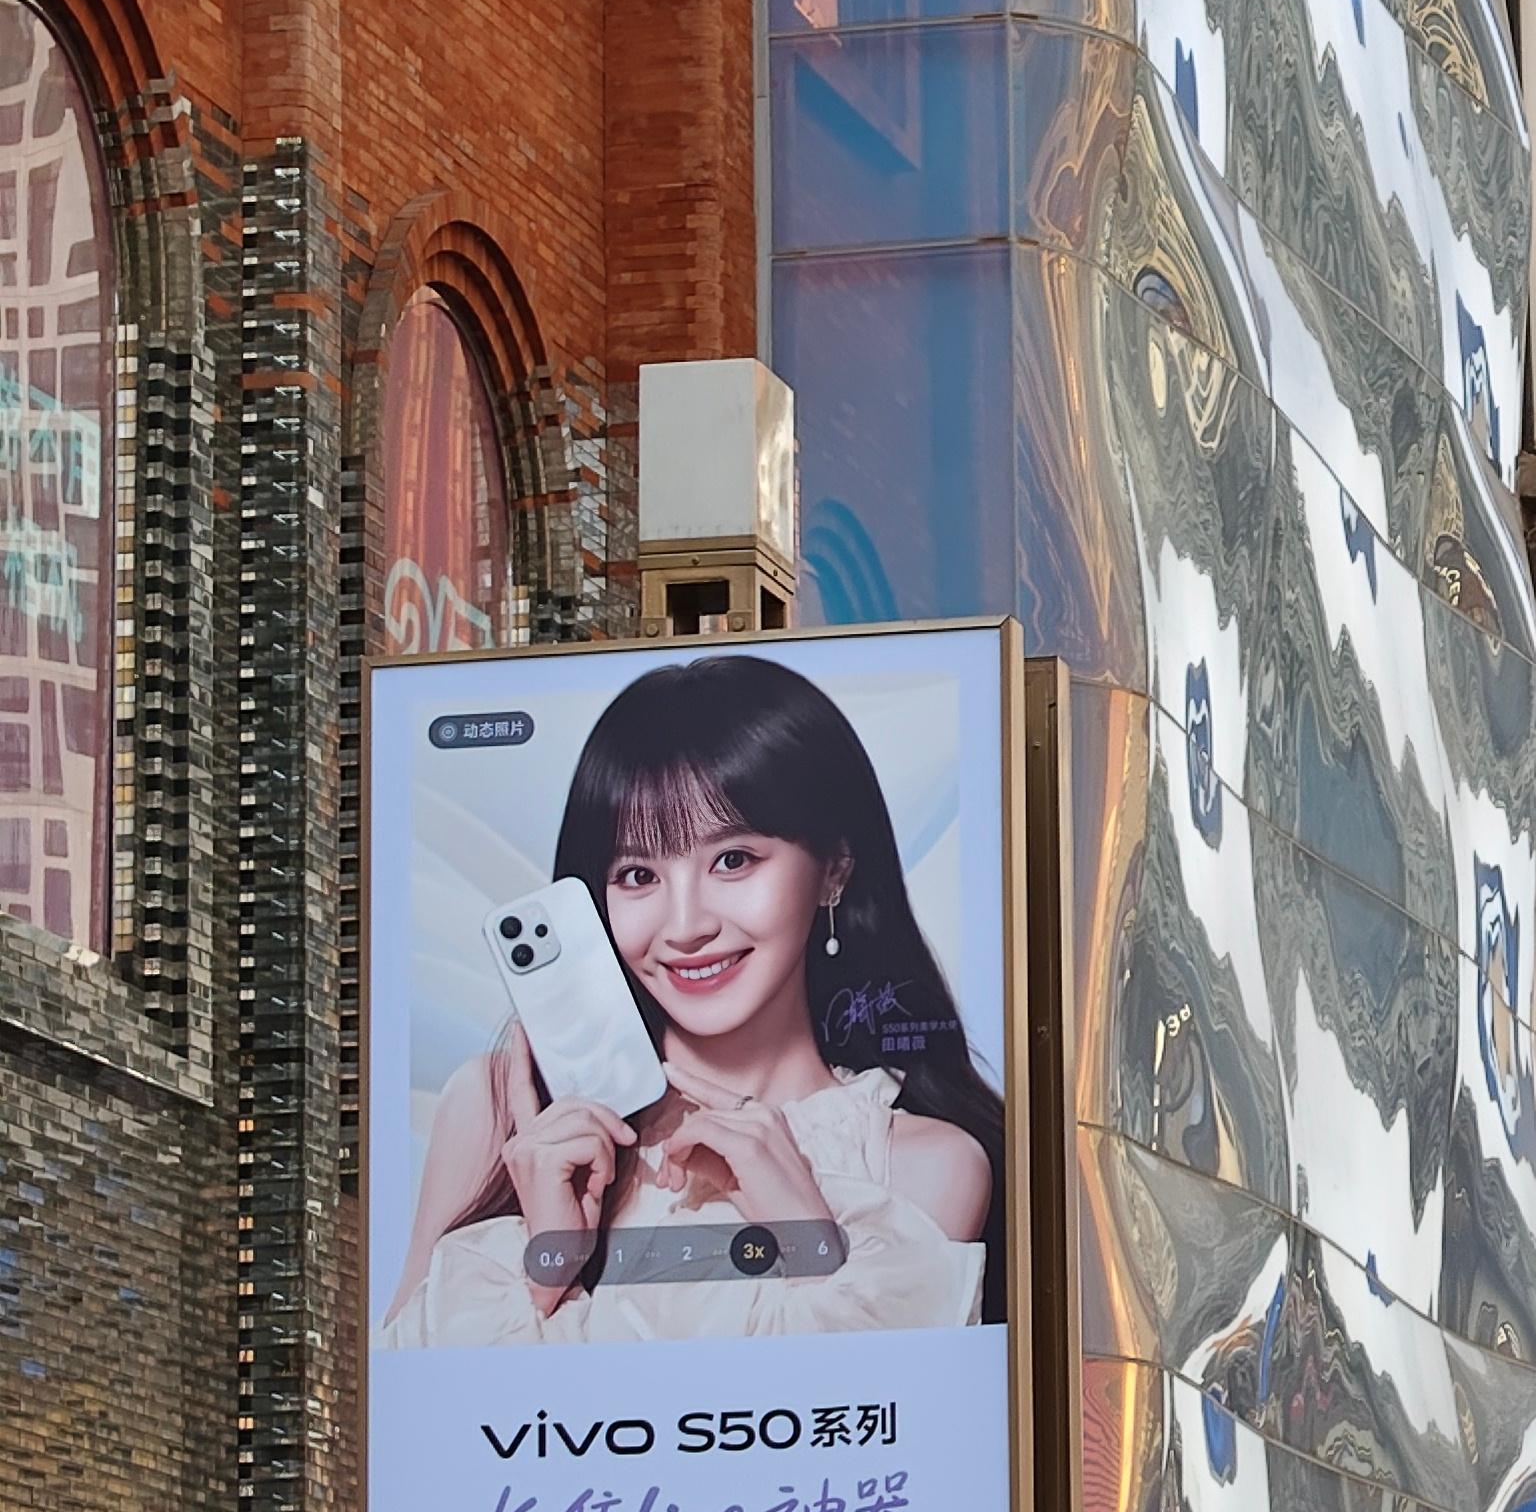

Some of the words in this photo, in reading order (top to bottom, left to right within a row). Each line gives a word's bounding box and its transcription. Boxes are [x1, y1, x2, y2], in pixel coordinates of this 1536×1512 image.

[463, 720, 525, 739] 动态照片
[540, 1251, 565, 1267] 0.6
[615, 1248, 623, 1264] 1
[682, 1245, 694, 1261] 2
[743, 1243, 765, 1260] 3x
[817, 1240, 829, 1256] 6
[480, 1409, 656, 1459] vivo
[676, 1402, 898, 1454] S50系列
